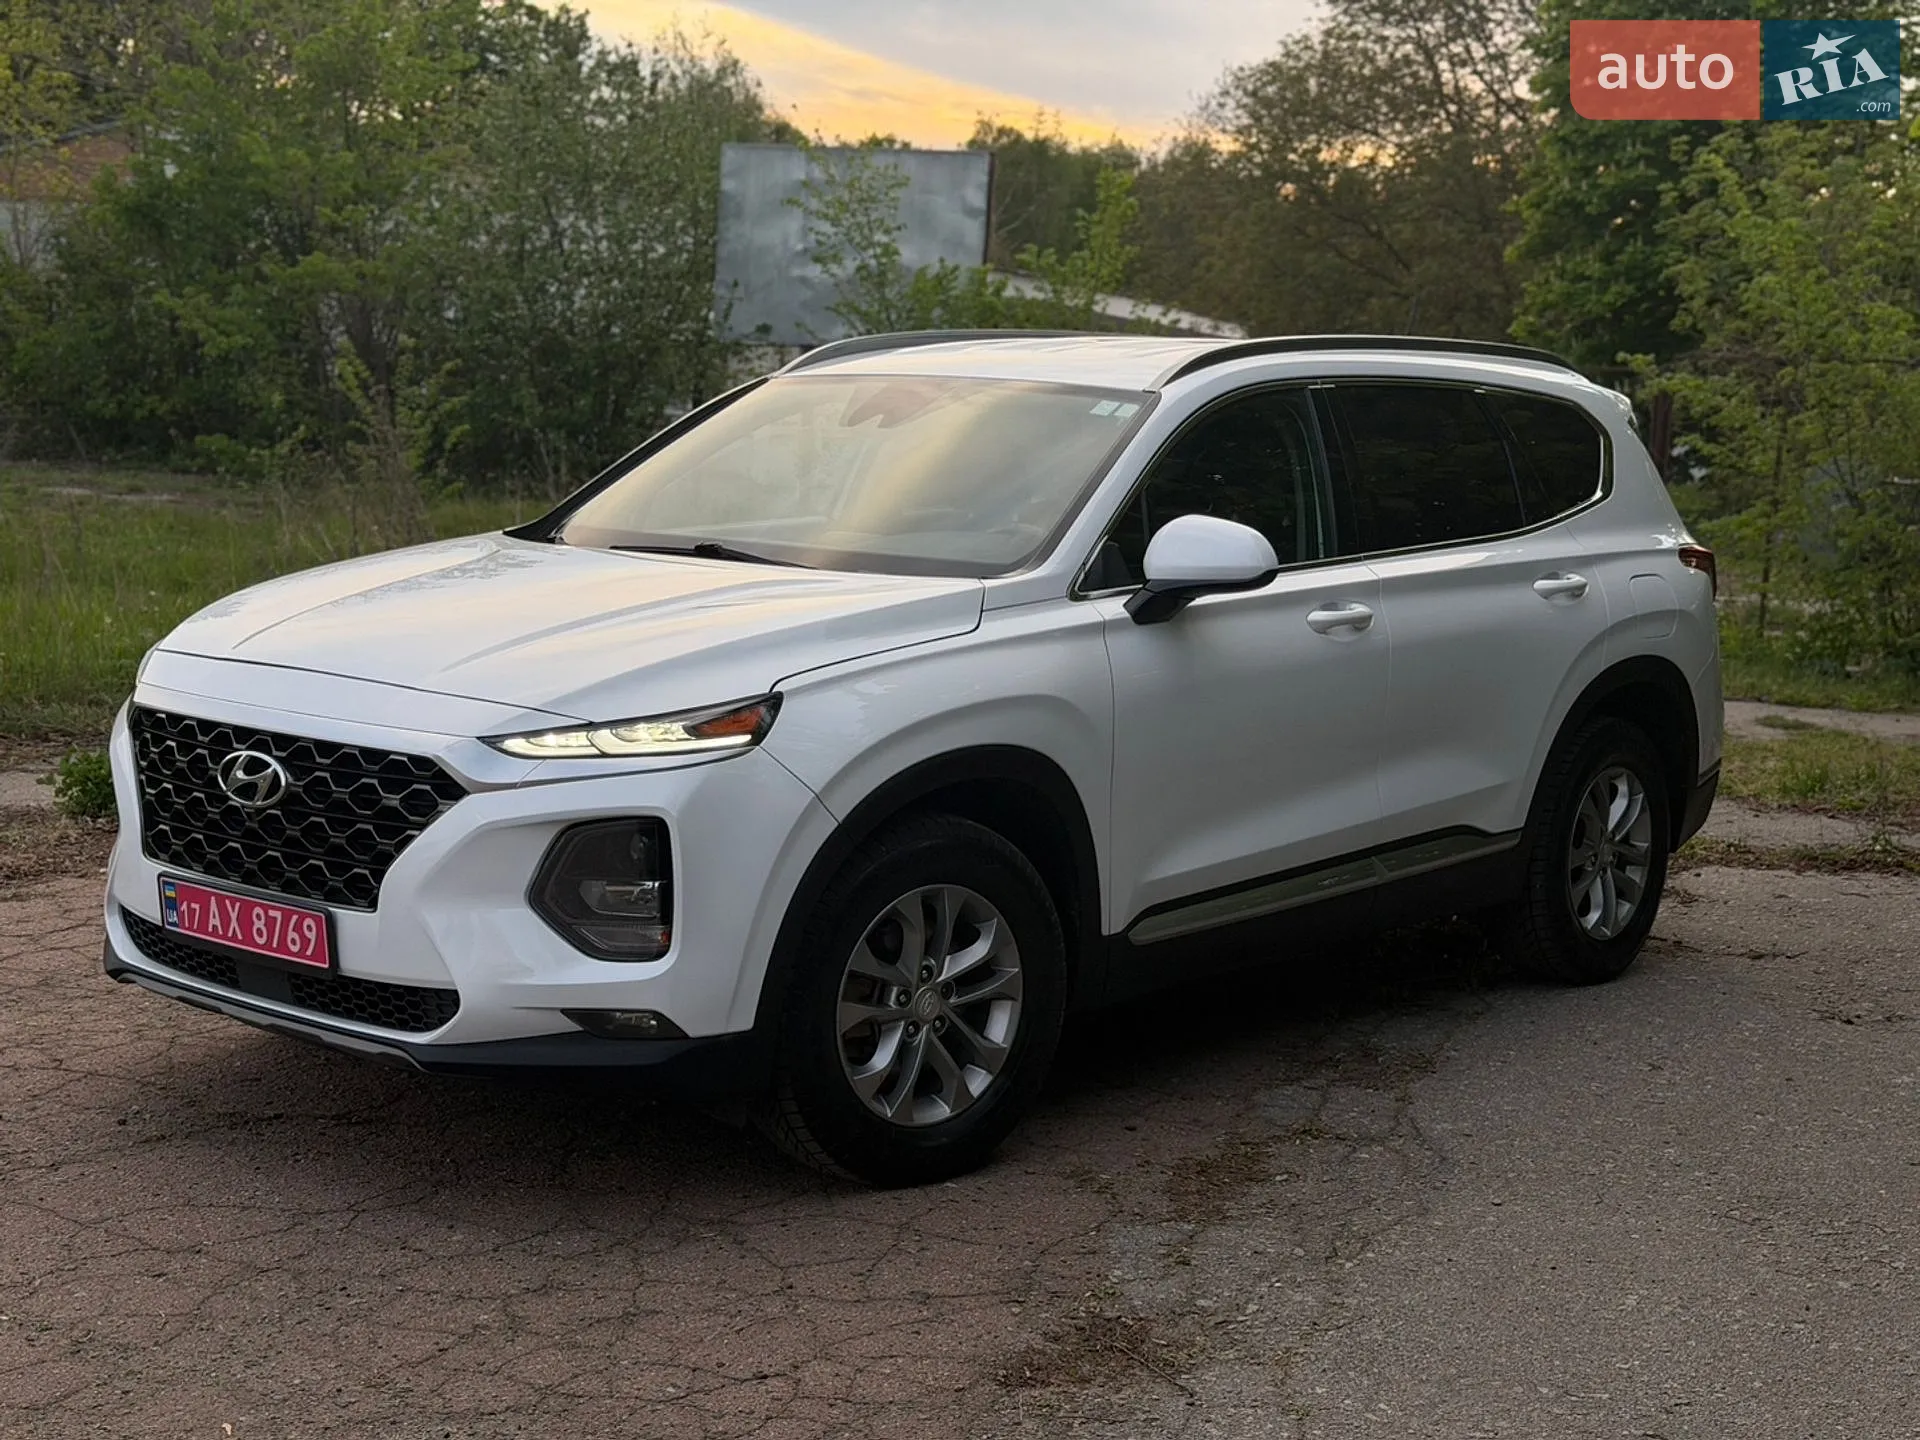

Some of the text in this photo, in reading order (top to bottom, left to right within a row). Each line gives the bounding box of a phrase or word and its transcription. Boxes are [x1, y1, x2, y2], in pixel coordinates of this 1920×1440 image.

[166, 909, 179, 925] UA
[180, 896, 317, 956] 17 AX 8769
